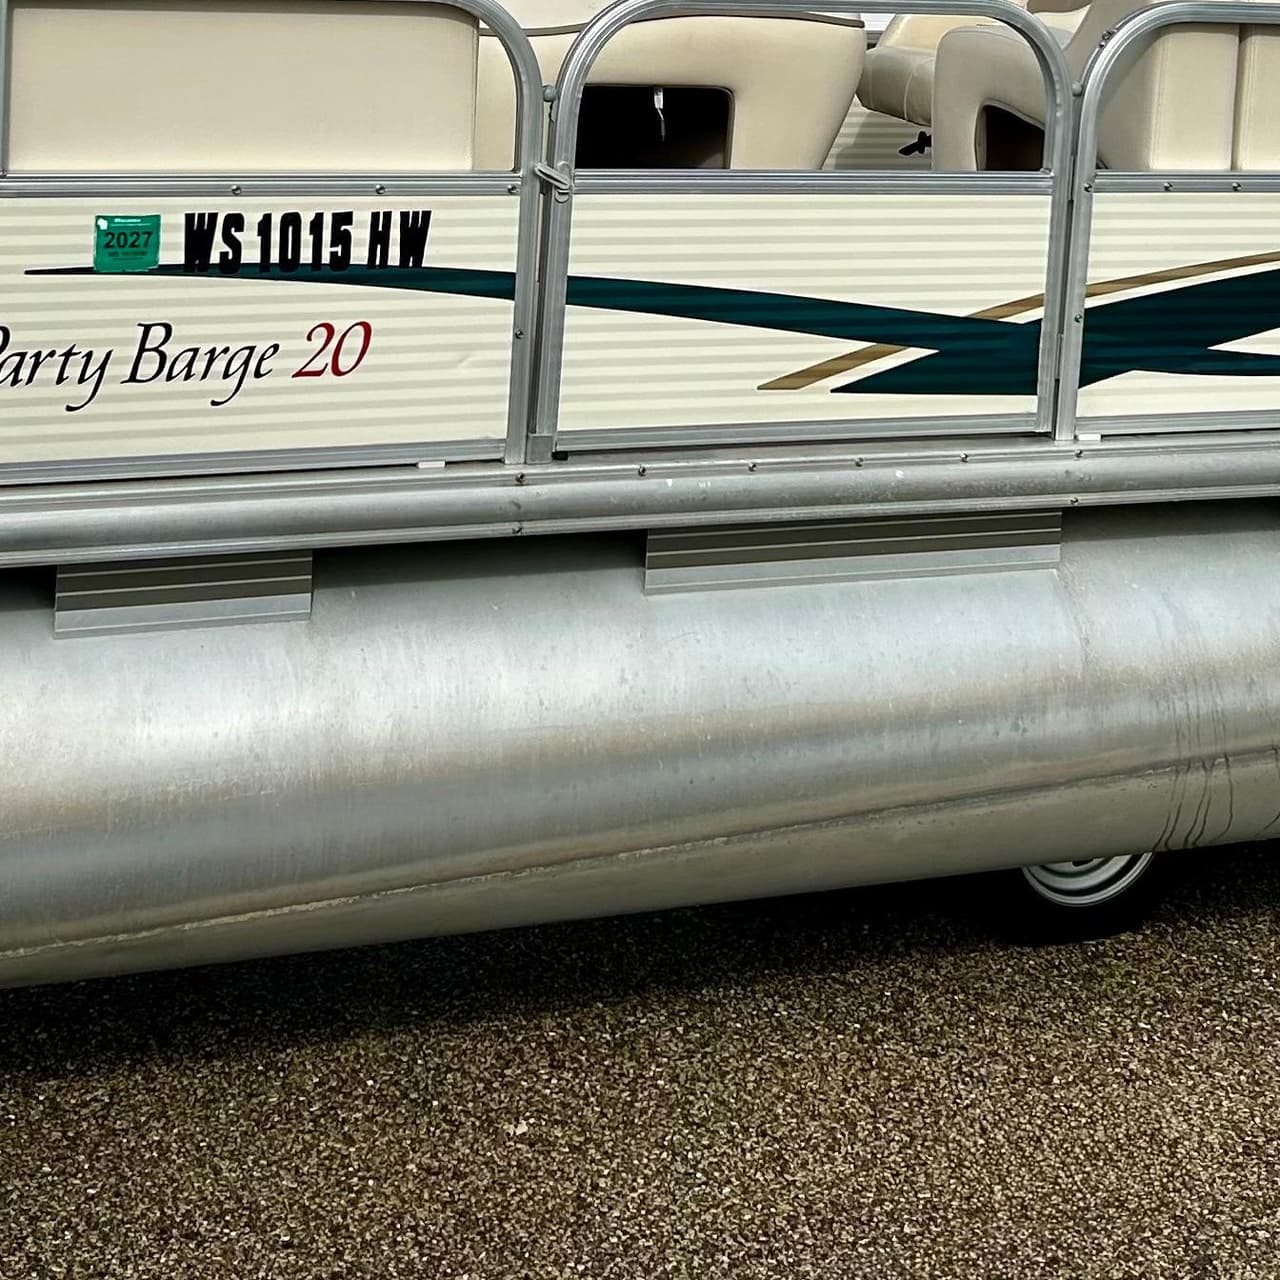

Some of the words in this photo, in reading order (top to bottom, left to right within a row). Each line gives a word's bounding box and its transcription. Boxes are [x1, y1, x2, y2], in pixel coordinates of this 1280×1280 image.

[103, 230, 154, 249] 2027
[183, 211, 245, 274] WS
[257, 210, 354, 273] 1015
[367, 210, 432, 270] HW
[120, 322, 280, 407] Barge
[291, 321, 372, 378] 20
